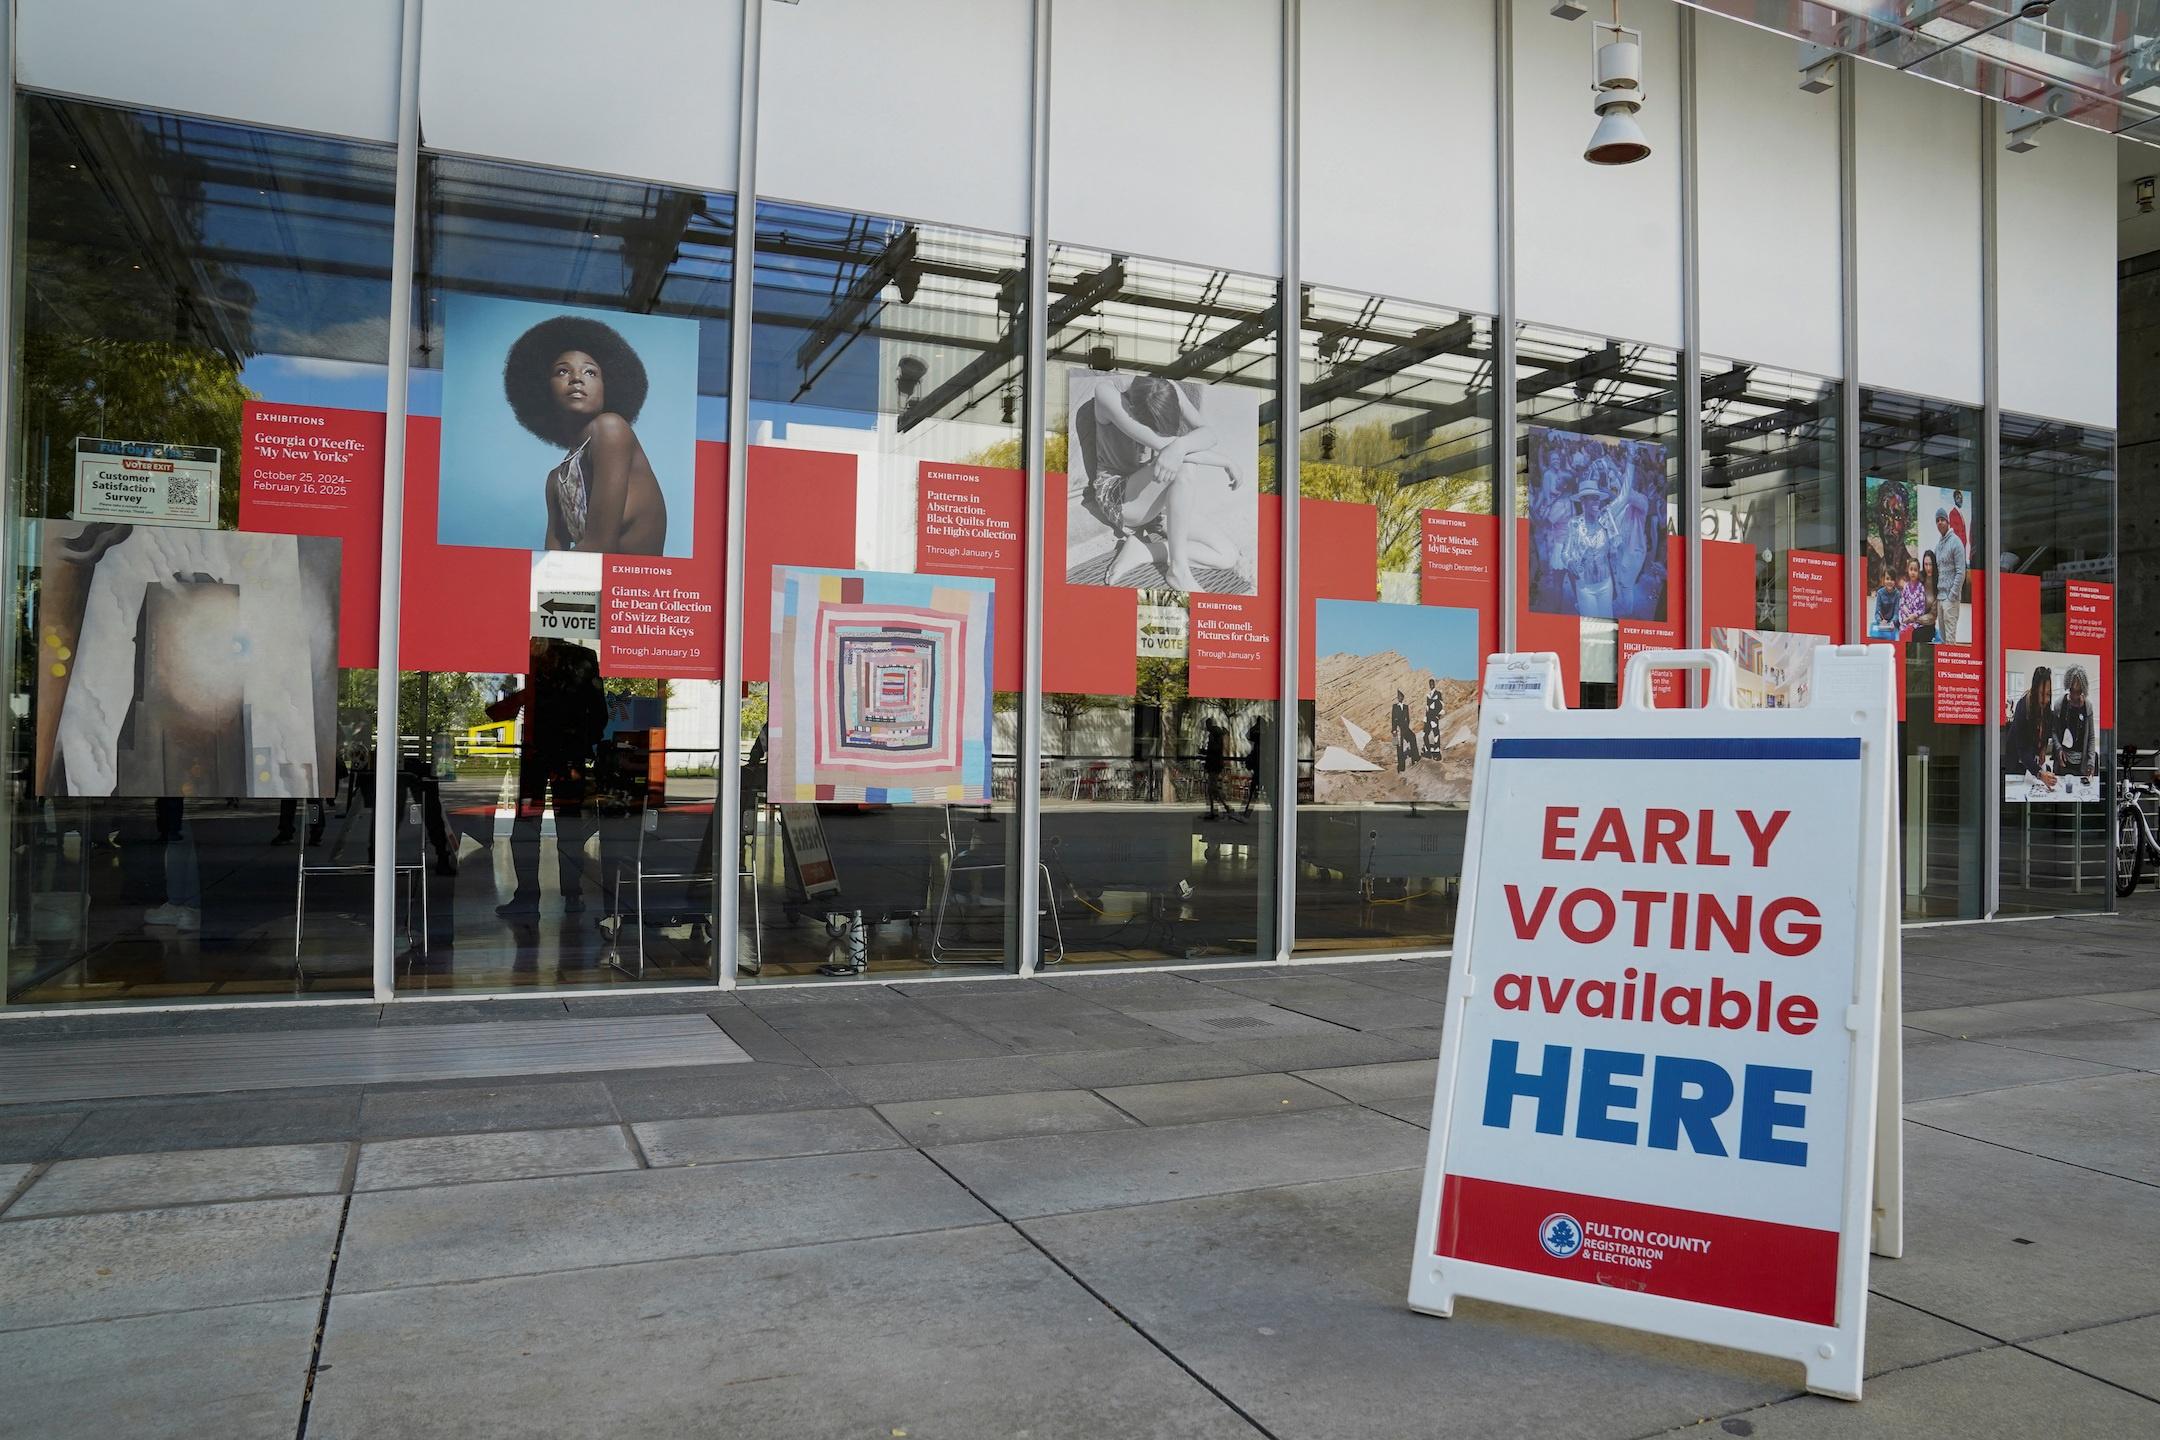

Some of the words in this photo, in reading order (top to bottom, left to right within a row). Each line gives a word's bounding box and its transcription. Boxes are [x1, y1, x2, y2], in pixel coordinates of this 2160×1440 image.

[256, 413, 325, 425] EXHIBITIONS
[255, 433, 306, 447] Georgia
[309, 437, 365, 451] O'Keeffe:
[282, 448, 310, 460] New
[125, 461, 152, 470] VOTER
[153, 463, 172, 471] EXIT
[99, 471, 150, 483] Customer
[254, 470, 297, 481] October
[928, 472, 979, 482] EXHIBITIONS
[92, 480, 155, 493] Satisfaction
[254, 481, 300, 494] February
[320, 486, 347, 495] 2025
[105, 492, 142, 504] Survey
[928, 491, 968, 502] Patterns
[970, 494, 980, 503] in
[927, 503, 986, 515] Abstraction:
[927, 514, 954, 524] Black
[956, 516, 984, 527] Quilts
[986, 518, 1010, 528] from
[1428, 518, 1466, 527] EXHIBITIONS
[927, 525, 941, 535] the
[944, 527, 970, 537] High's
[972, 529, 1017, 540] Collection
[1428, 534, 1447, 544] Tyler
[1449, 536, 1479, 546] Mitchell:
[926, 545, 960, 557] Through
[962, 547, 993, 559] January
[995, 550, 1001, 558] 5
[1428, 544, 1451, 555] Idyllic
[1452, 547, 1473, 556] Space
[613, 566, 672, 576] EXHIBITIONS
[1428, 562, 1453, 572] Through
[1454, 564, 1484, 573] December
[1793, 571, 1810, 581] Friday
[1811, 573, 1823, 581] Jazz
[612, 586, 650, 598] Giants:
[653, 589, 670, 599] Art
[672, 590, 700, 600] from
[612, 600, 629, 609] the
[631, 601, 658, 610] Dean
[660, 602, 712, 613] Collection
[1198, 602, 1242, 611] EXHIBITIONS
[541, 616, 558, 628] TO
[562, 617, 596, 630] VOTE
[611, 612, 623, 621] of
[625, 612, 657, 623] Swizz
[660, 614, 690, 624] Beatz
[611, 625, 632, 634] and
[636, 626, 666, 636] Alicia
[669, 627, 694, 638] Keys
[1198, 620, 1216, 629] Kelli
[1218, 621, 1252, 631] Connell:
[1198, 631, 1231, 641] Pictures
[1231, 632, 1244, 641] for
[1246, 634, 1270, 643] Charis
[1141, 638, 1155, 649] TO
[1158, 639, 1183, 650] VOTE
[1624, 643, 1641, 651] HIGH
[611, 646, 650, 657] Through
[652, 648, 687, 659] January
[690, 649, 701, 657] 19
[1197, 649, 1227, 660] Through
[1227, 651, 1255, 661] January
[1256, 652, 1261, 660] 5
[1541, 806, 1791, 868] EARLY
[1503, 884, 1822, 957] VOTING
[1493, 967, 1819, 1036] available
[1483, 1039, 1813, 1167] HERE
[1585, 1222, 1645, 1243] FULTON
[1647, 1232, 1712, 1254] COUNTY
[1584, 1238, 1664, 1260] REGISTRATION
[1582, 1250, 1590, 1259] &
[1593, 1252, 1653, 1270] ELECTIONS
